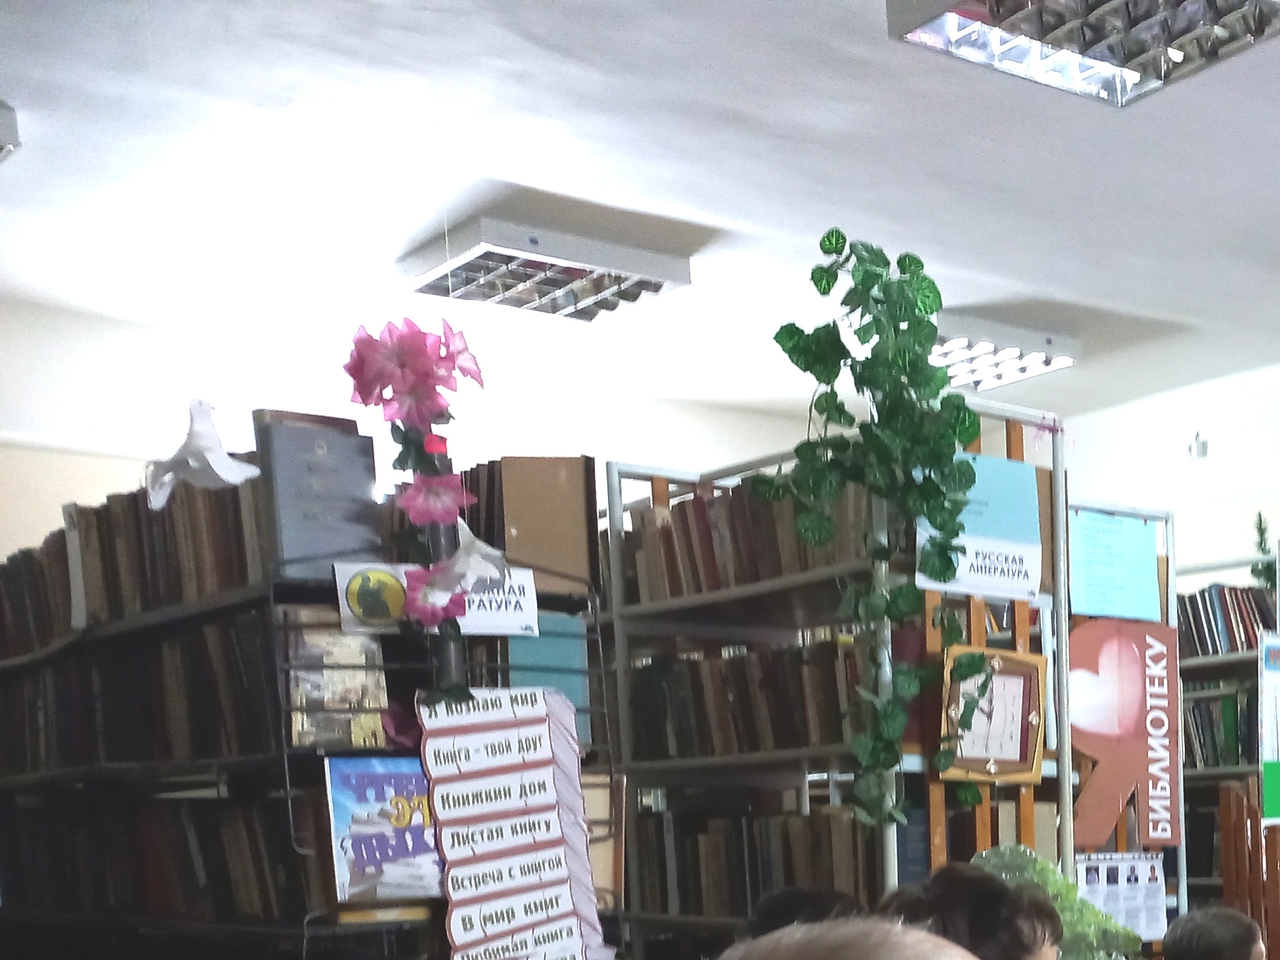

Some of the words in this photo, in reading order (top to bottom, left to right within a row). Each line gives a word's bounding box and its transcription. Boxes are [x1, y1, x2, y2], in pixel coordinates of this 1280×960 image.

[969, 562, 1030, 581] ЛИТЕРАТУРА
[975, 550, 1024, 568] РУССКАЯ
[510, 691, 538, 709] мир
[433, 745, 471, 767] Книга
[484, 738, 512, 757] твой
[518, 734, 543, 754] друг
[1145, 634, 1171, 839] БИБЛИОТЕКУ
[440, 785, 512, 811] Книжкин
[519, 779, 547, 799] дом
[450, 826, 504, 850] Листая
[510, 818, 551, 838] книгу
[450, 868, 503, 891] Встреча
[508, 866, 515, 880] с
[519, 854, 563, 877] книгой
[461, 914, 474, 933] В
[482, 906, 516, 928] мир
[523, 893, 562, 917] книг
[533, 924, 574, 948] книга
